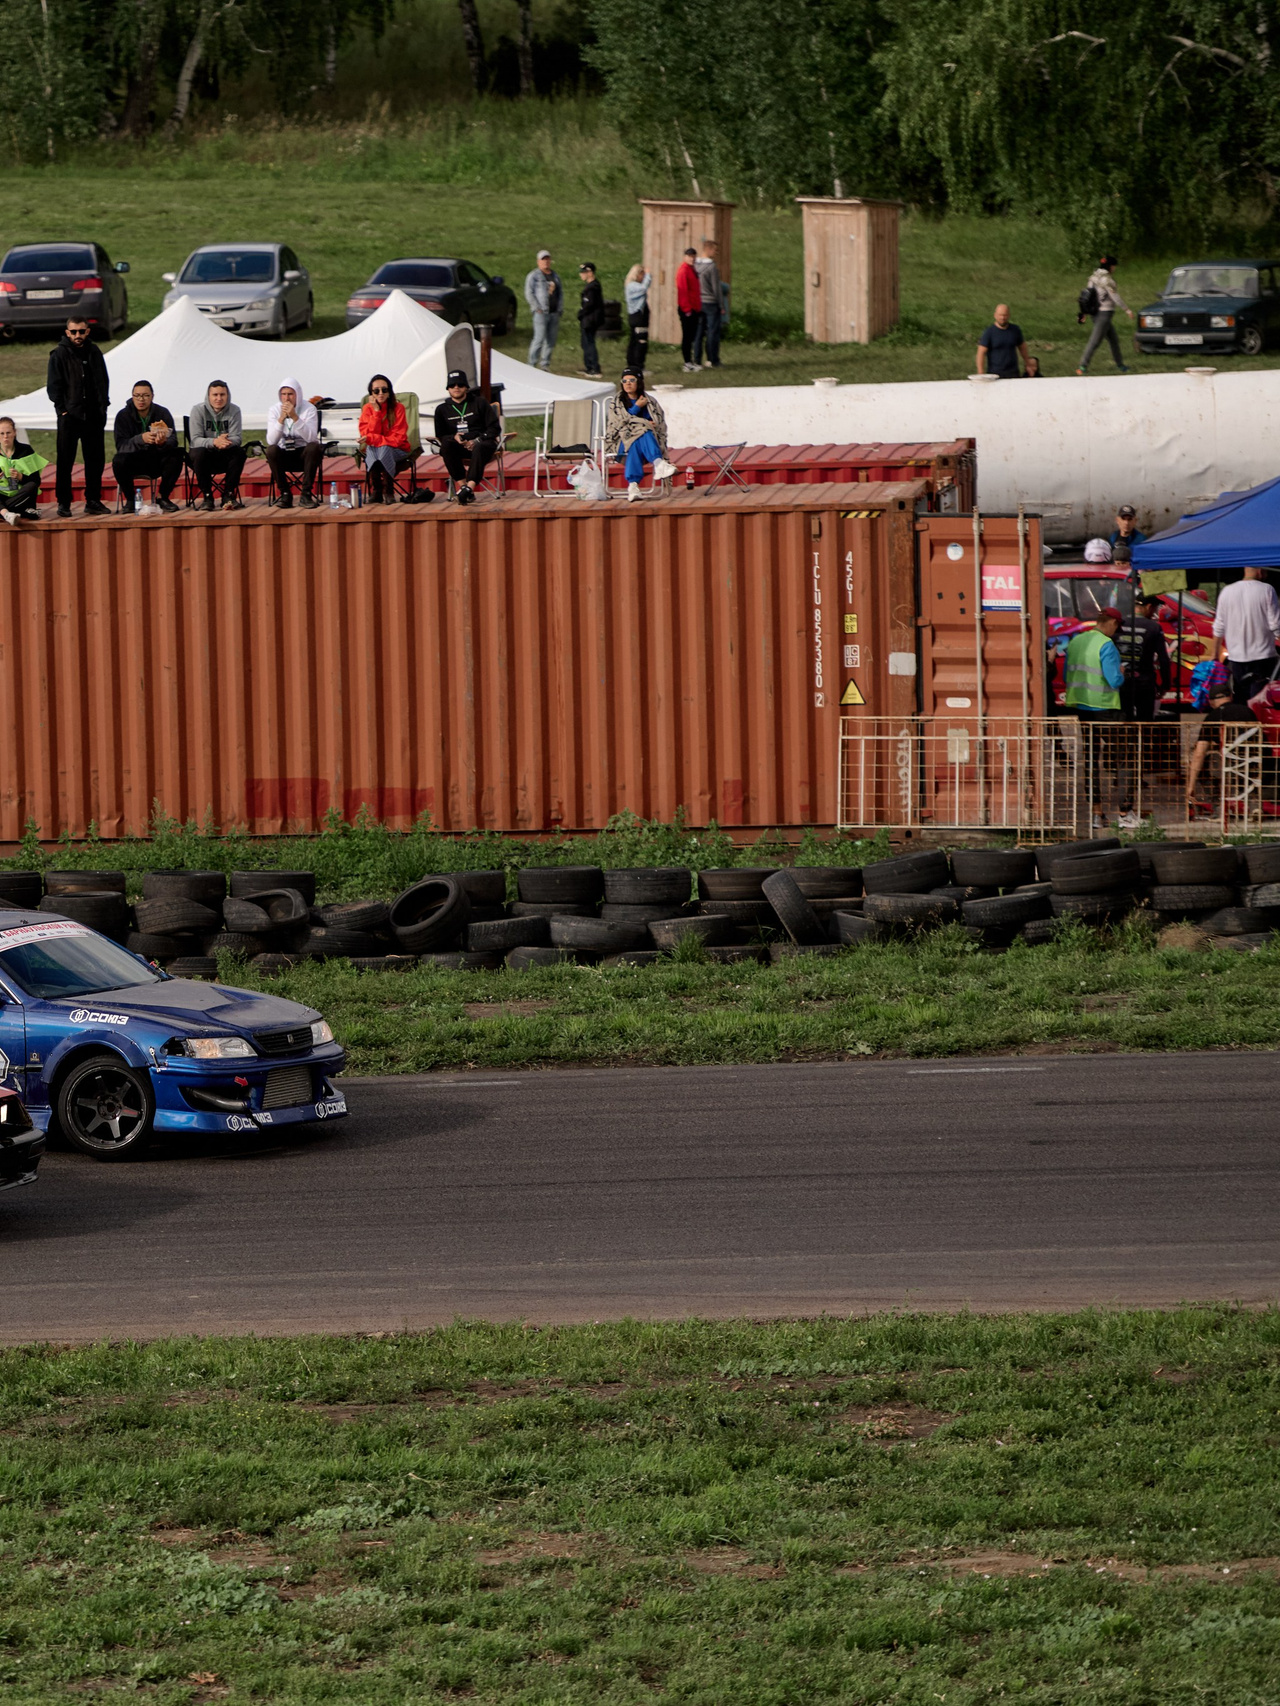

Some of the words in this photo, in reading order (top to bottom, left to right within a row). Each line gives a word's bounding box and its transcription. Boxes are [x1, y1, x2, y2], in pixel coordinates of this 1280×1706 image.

[813, 552, 822, 605] TCLU
[845, 551, 854, 604] 45G1
[982, 576, 1021, 590] TAL
[814, 608, 823, 688] 855380
[815, 692, 824, 708] 2
[4, 923, 61, 937] БАРНАУЛЬСКОЙ
[88, 1012, 129, 1025] СОЮЗ
[327, 1102, 347, 1115] СОЮЗ
